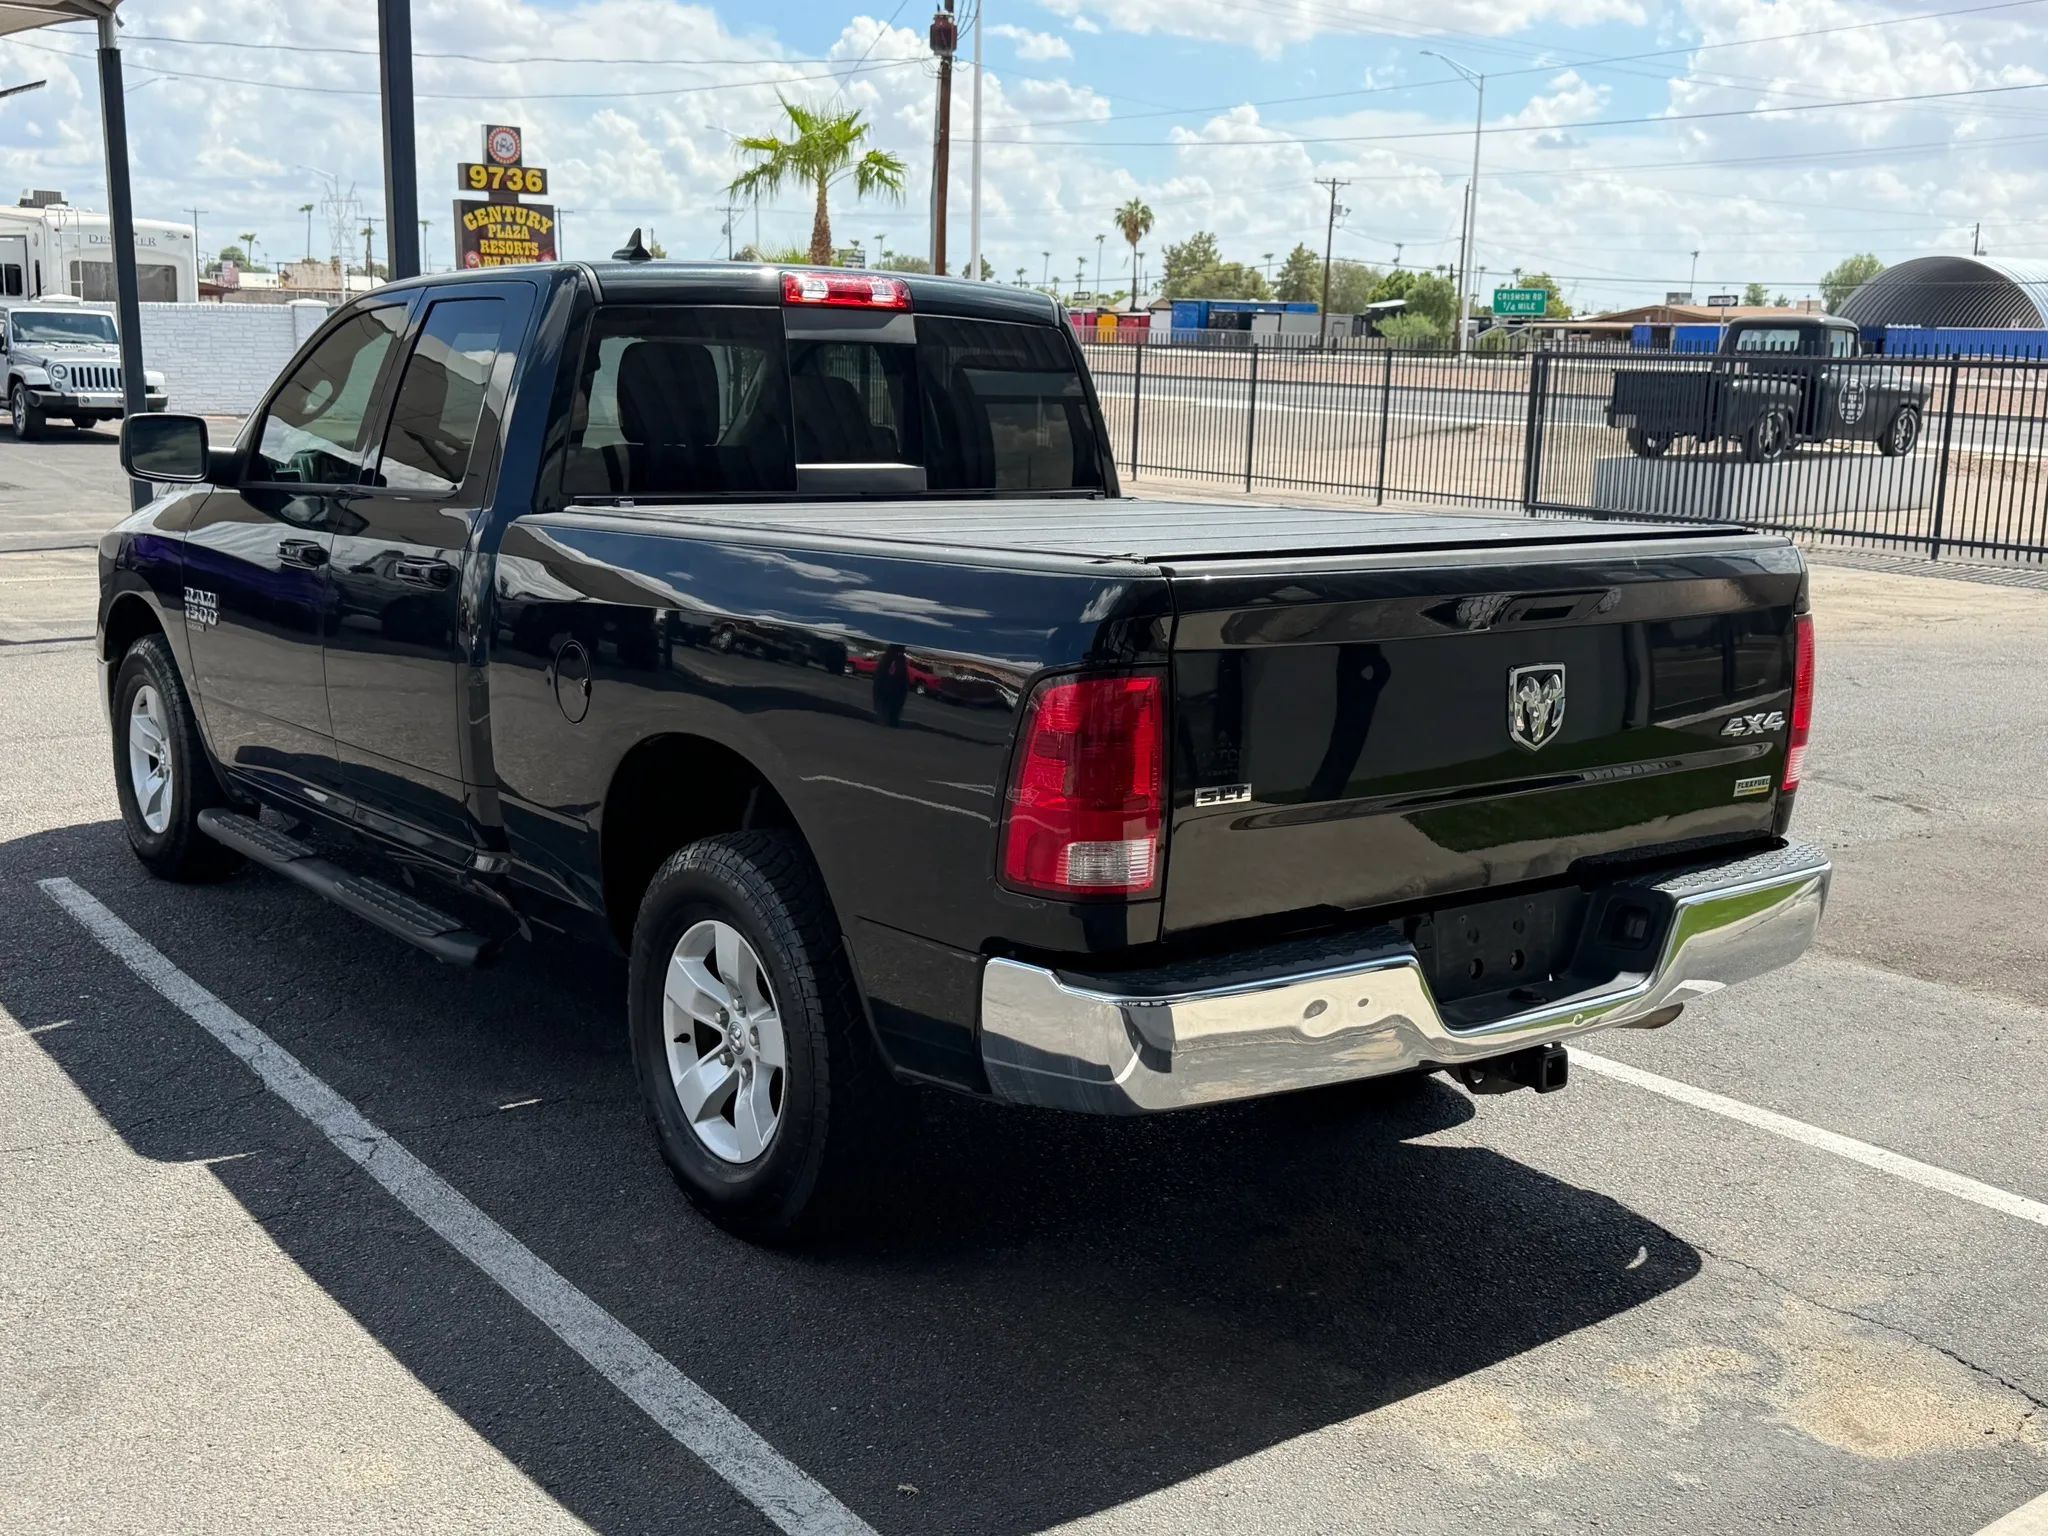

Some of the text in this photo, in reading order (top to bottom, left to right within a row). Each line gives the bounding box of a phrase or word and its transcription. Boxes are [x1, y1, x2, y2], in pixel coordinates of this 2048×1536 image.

[469, 165, 543, 192] 9736
[463, 205, 553, 235] CENTURY
[487, 224, 530, 240] PLAZA
[480, 240, 539, 256] RESORTS
[1503, 301, 1515, 311] 1/4
[184, 586, 217, 608] RAM
[185, 603, 219, 626] 1500
[1197, 784, 1251, 806] SLT
